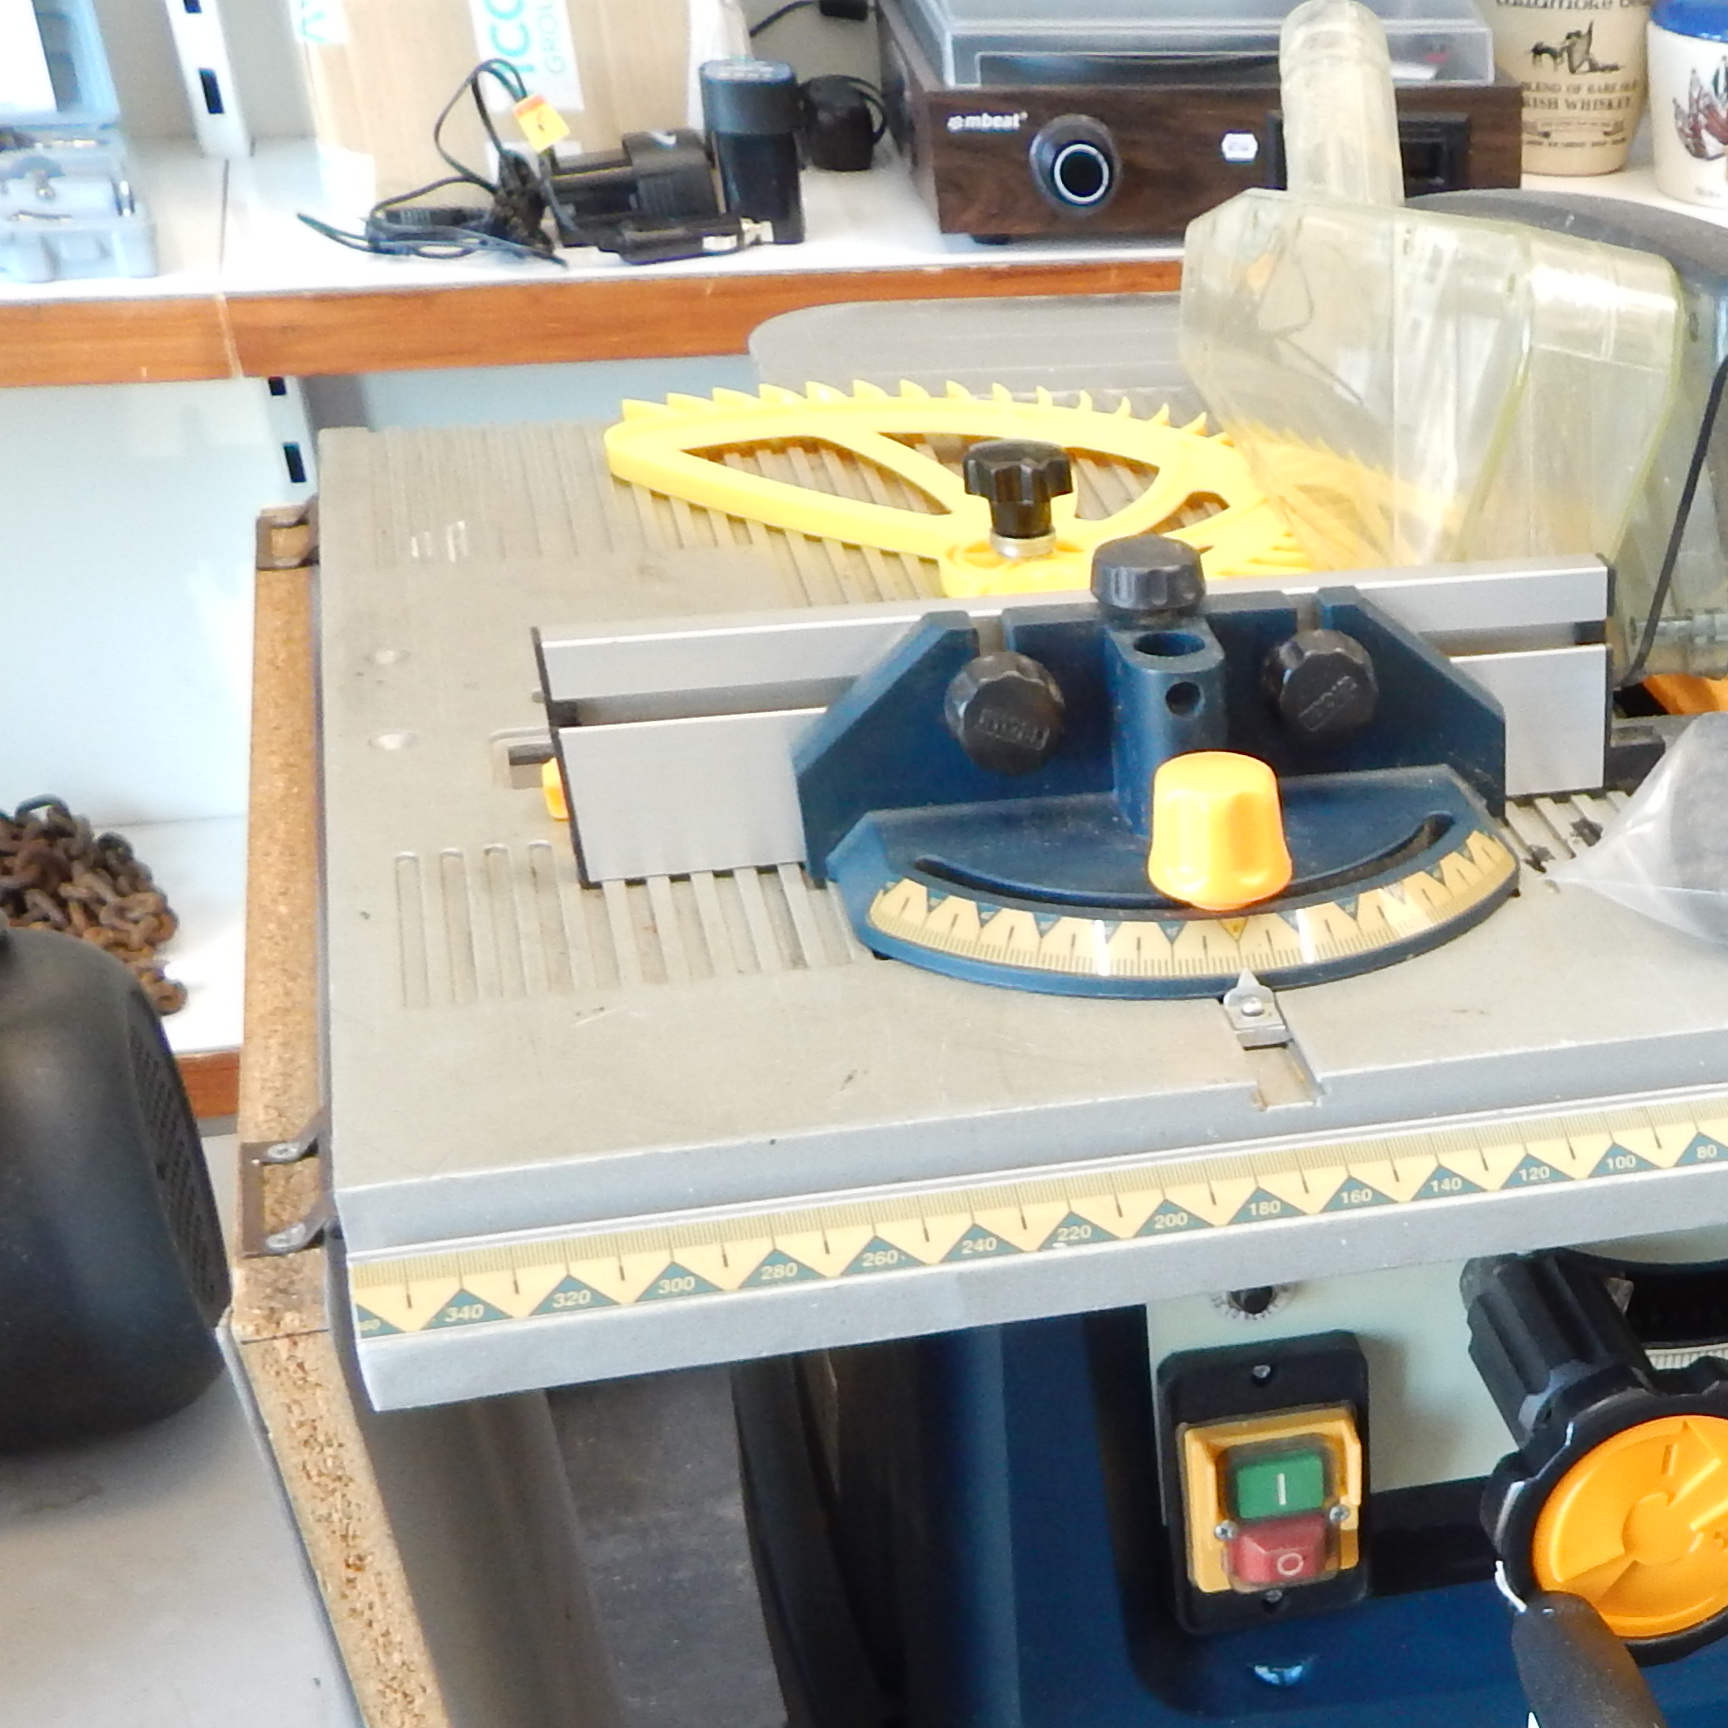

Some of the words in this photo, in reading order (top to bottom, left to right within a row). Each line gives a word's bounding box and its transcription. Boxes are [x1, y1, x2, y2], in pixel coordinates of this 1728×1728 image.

[444, 1304, 484, 1322] 340
[553, 1290, 591, 1308] 320
[658, 1276, 695, 1294] 300
[761, 1263, 798, 1280] 280
[862, 1250, 898, 1267] 260
[961, 1237, 997, 1254] 240
[1057, 1225, 1091, 1242] 220
[1154, 1212, 1188, 1229] 200
[1249, 1200, 1281, 1216] 180
[1340, 1188, 1372, 1204] 160
[1430, 1176, 1462, 1192] 140
[1519, 1166, 1549, 1181] 120
[1606, 1155, 1636, 1170] 100
[1696, 1144, 1718, 1159] 80
